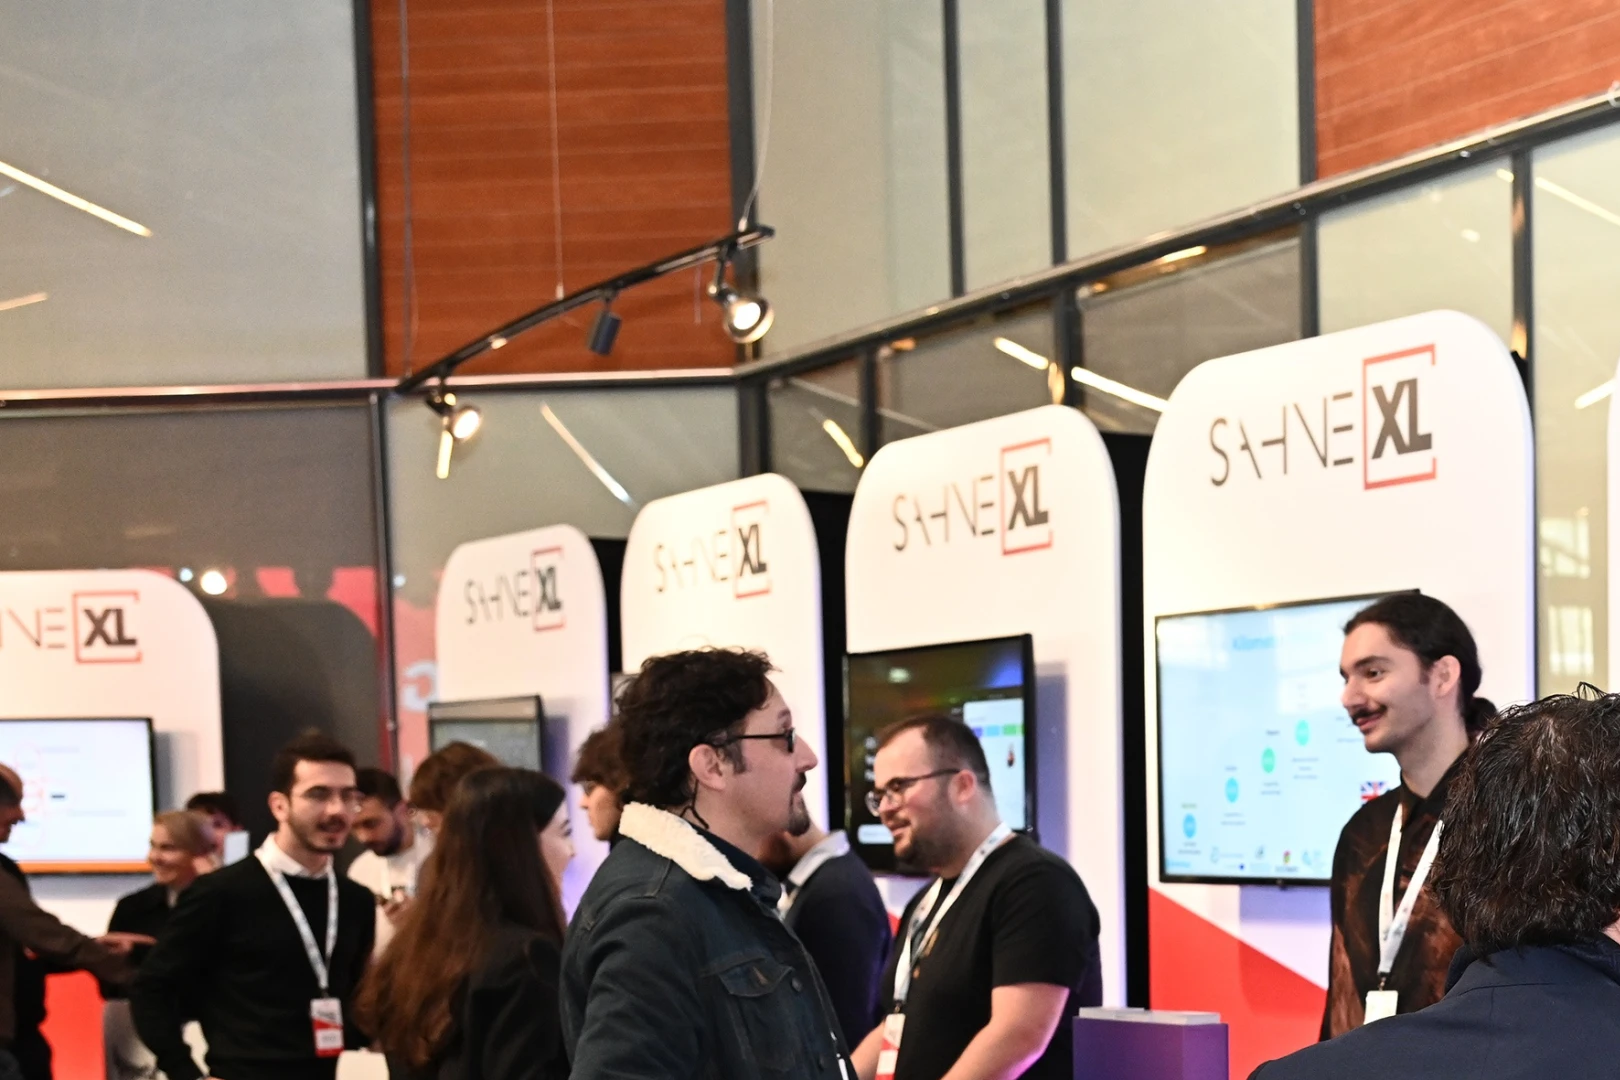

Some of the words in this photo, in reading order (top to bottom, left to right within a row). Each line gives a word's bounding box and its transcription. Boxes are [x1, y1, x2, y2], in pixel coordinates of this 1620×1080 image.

[1209, 391, 1354, 487] SAHNE
[1371, 378, 1432, 460] XL
[1007, 465, 1049, 530] XL
[738, 523, 767, 577] XL
[0, 608, 66, 650] NE
[83, 608, 137, 646] XL
